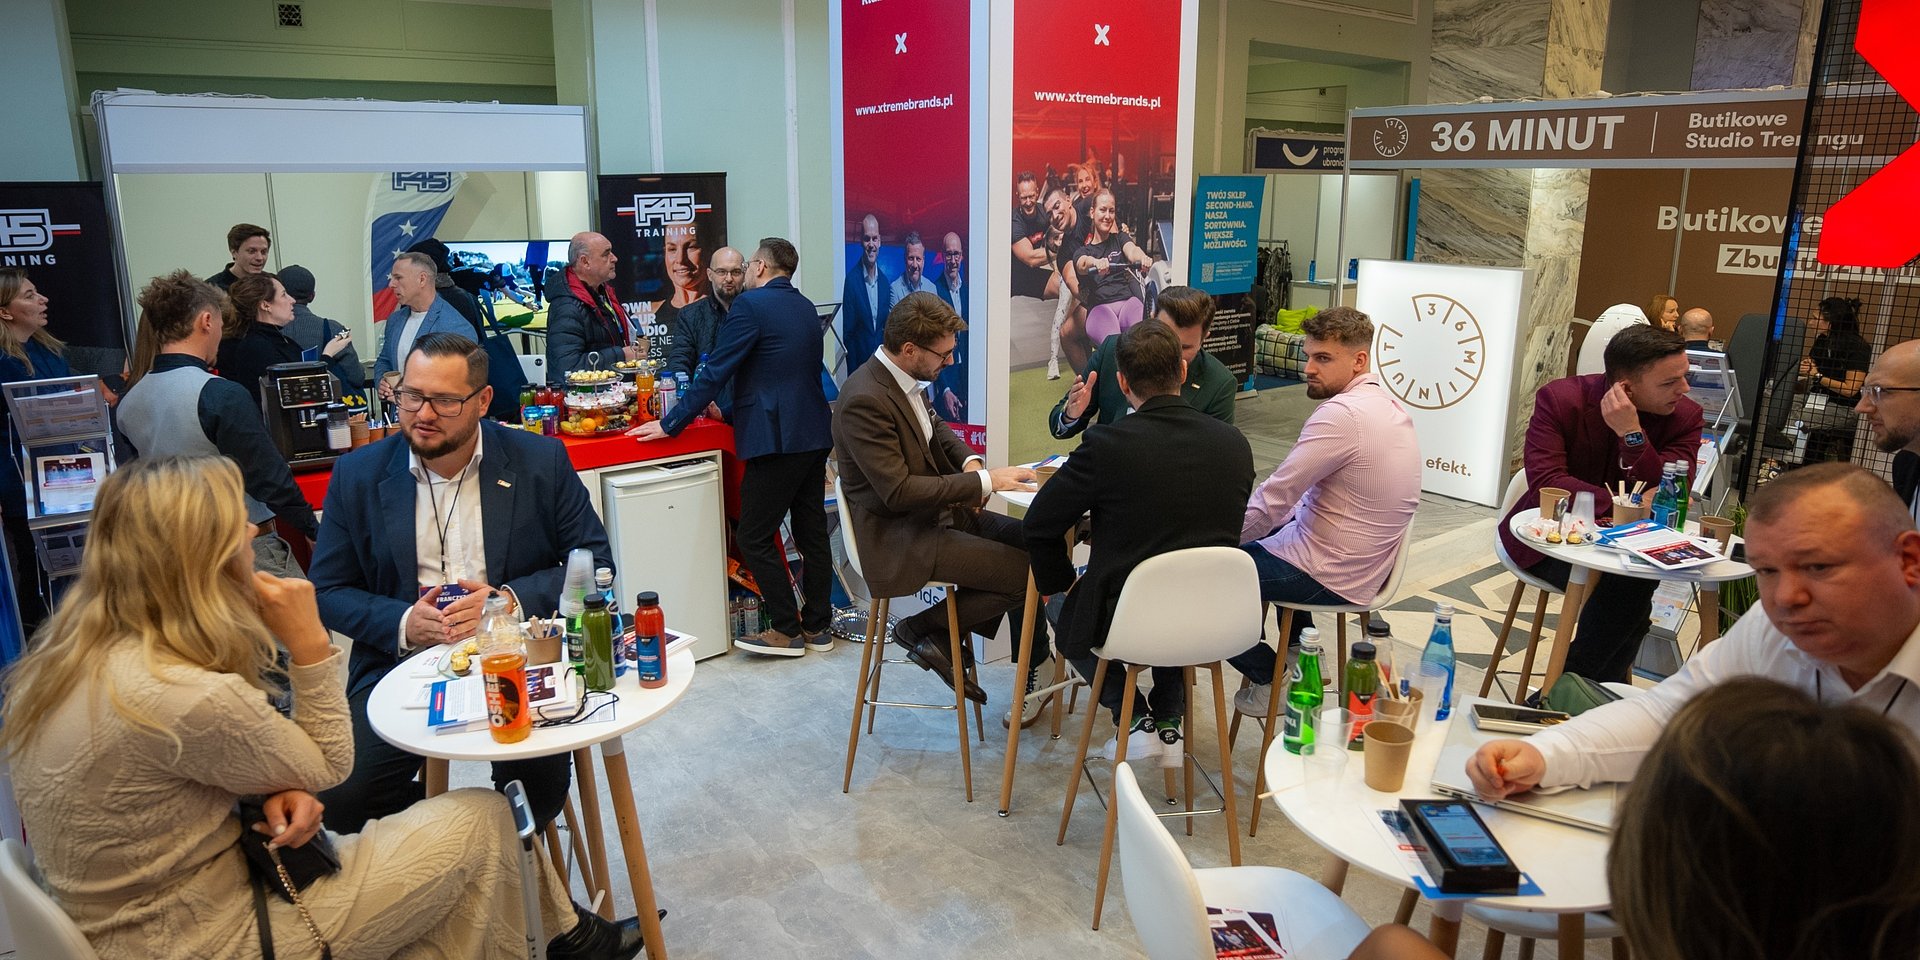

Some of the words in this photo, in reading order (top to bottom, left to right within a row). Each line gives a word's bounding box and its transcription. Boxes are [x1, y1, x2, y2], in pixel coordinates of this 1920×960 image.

[855, 94, 953, 116] www.xtremebrands.pl
[1034, 91, 1161, 110] www.xtremebrands.pl
[1688, 111, 1788, 128] Butikowe
[1430, 121, 1476, 152] 36
[1487, 115, 1625, 150] MINUT
[1685, 132, 1754, 149] Studio
[1760, 131, 1864, 150] Trengu
[1227, 191, 1246, 199] SKLEP
[635, 194, 694, 225] F45
[1205, 211, 1228, 219] NASZA
[636, 226, 696, 237] TRAINING
[1426, 457, 1471, 477] efekt.
[484, 673, 504, 728] OSHEE
